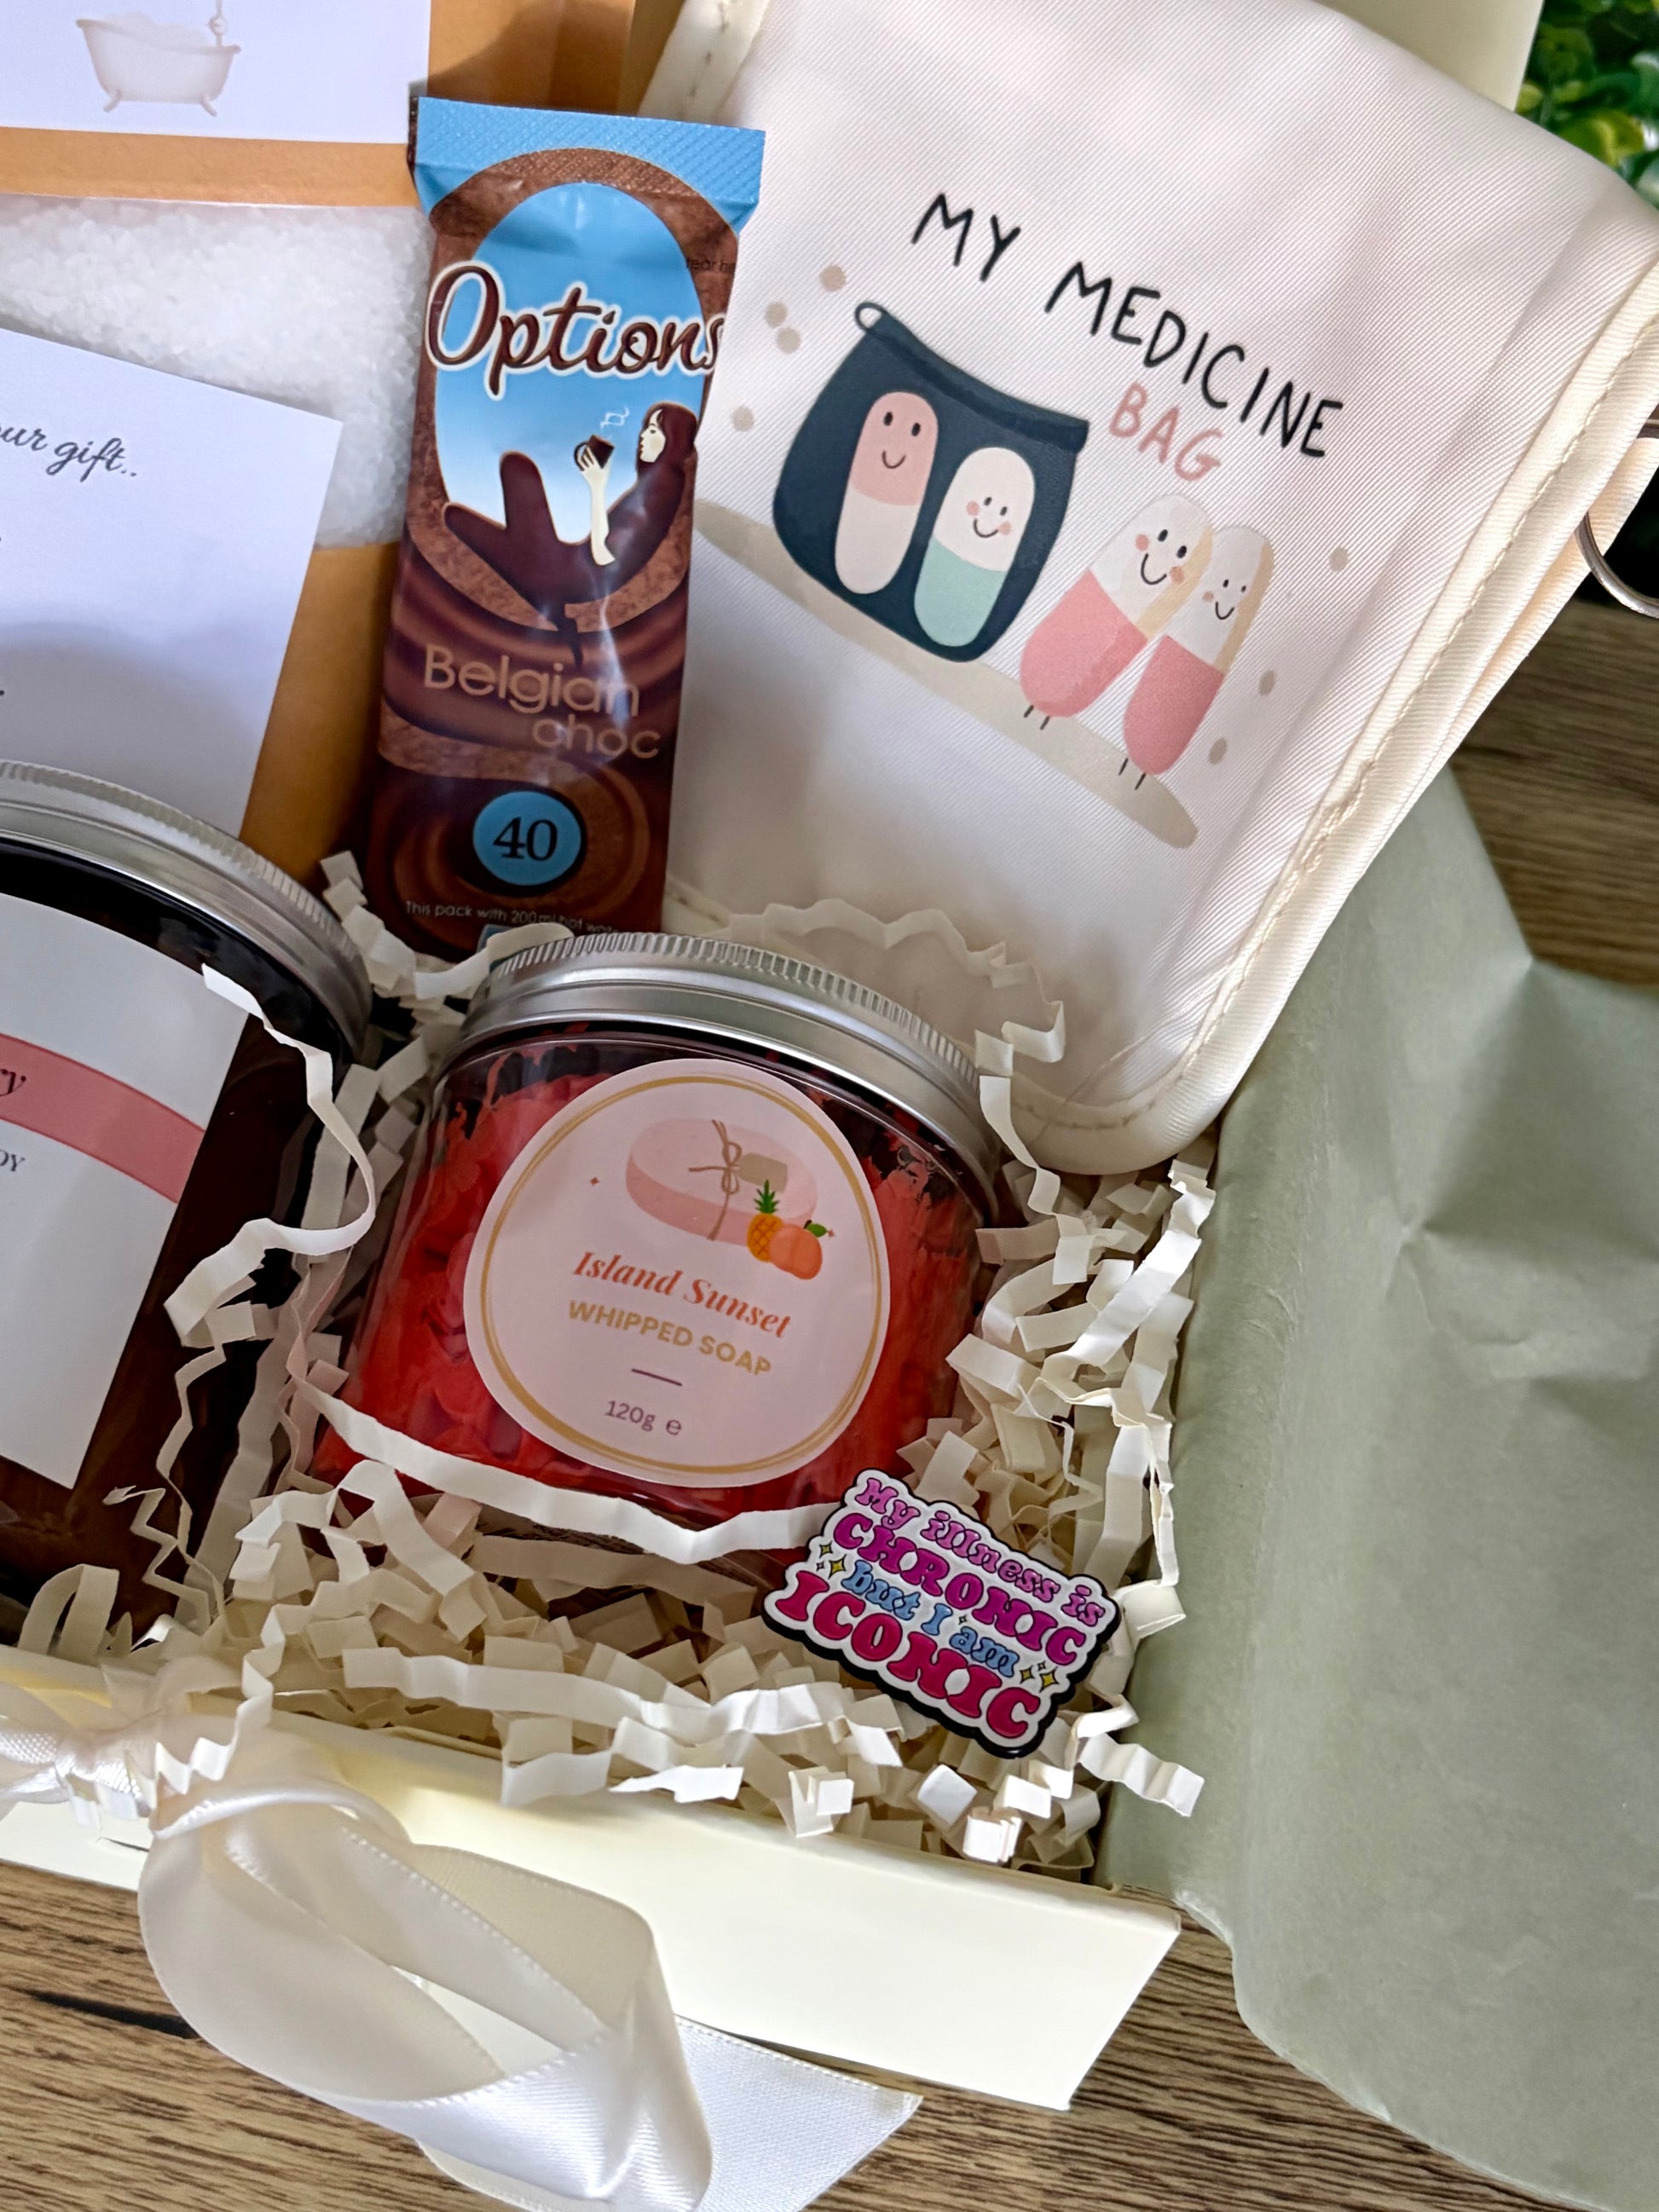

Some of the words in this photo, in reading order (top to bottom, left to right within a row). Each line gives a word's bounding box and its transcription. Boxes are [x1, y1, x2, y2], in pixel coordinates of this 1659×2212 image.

[428, 264, 725, 396] Options
[911, 193, 1020, 282] MY
[1044, 262, 1344, 458] MEDICINE
[0, 426, 48, 452] ur
[1108, 382, 1225, 482] BAG
[424, 645, 639, 717] Belgian
[532, 713, 660, 759] choc
[492, 816, 558, 862] 40
[406, 900, 431, 915] This
[435, 904, 472, 918] pack
[477, 907, 507, 921] with
[574, 1251, 684, 1296] Island
[683, 1278, 791, 1337] Sunset
[568, 1300, 693, 1347] WHIPPED
[699, 1335, 772, 1376] SOAP
[604, 1400, 656, 1432] 120g
[833, 1512, 1087, 1666] CHRONIC
[854, 1477, 921, 1530] My
[920, 1510, 1061, 1603] illness
[1061, 1585, 1106, 1627] is
[775, 1570, 1041, 1739] ICONIC
[841, 1559, 922, 1620] but
[921, 1603, 953, 1636] I
[949, 1626, 1020, 1678] am
